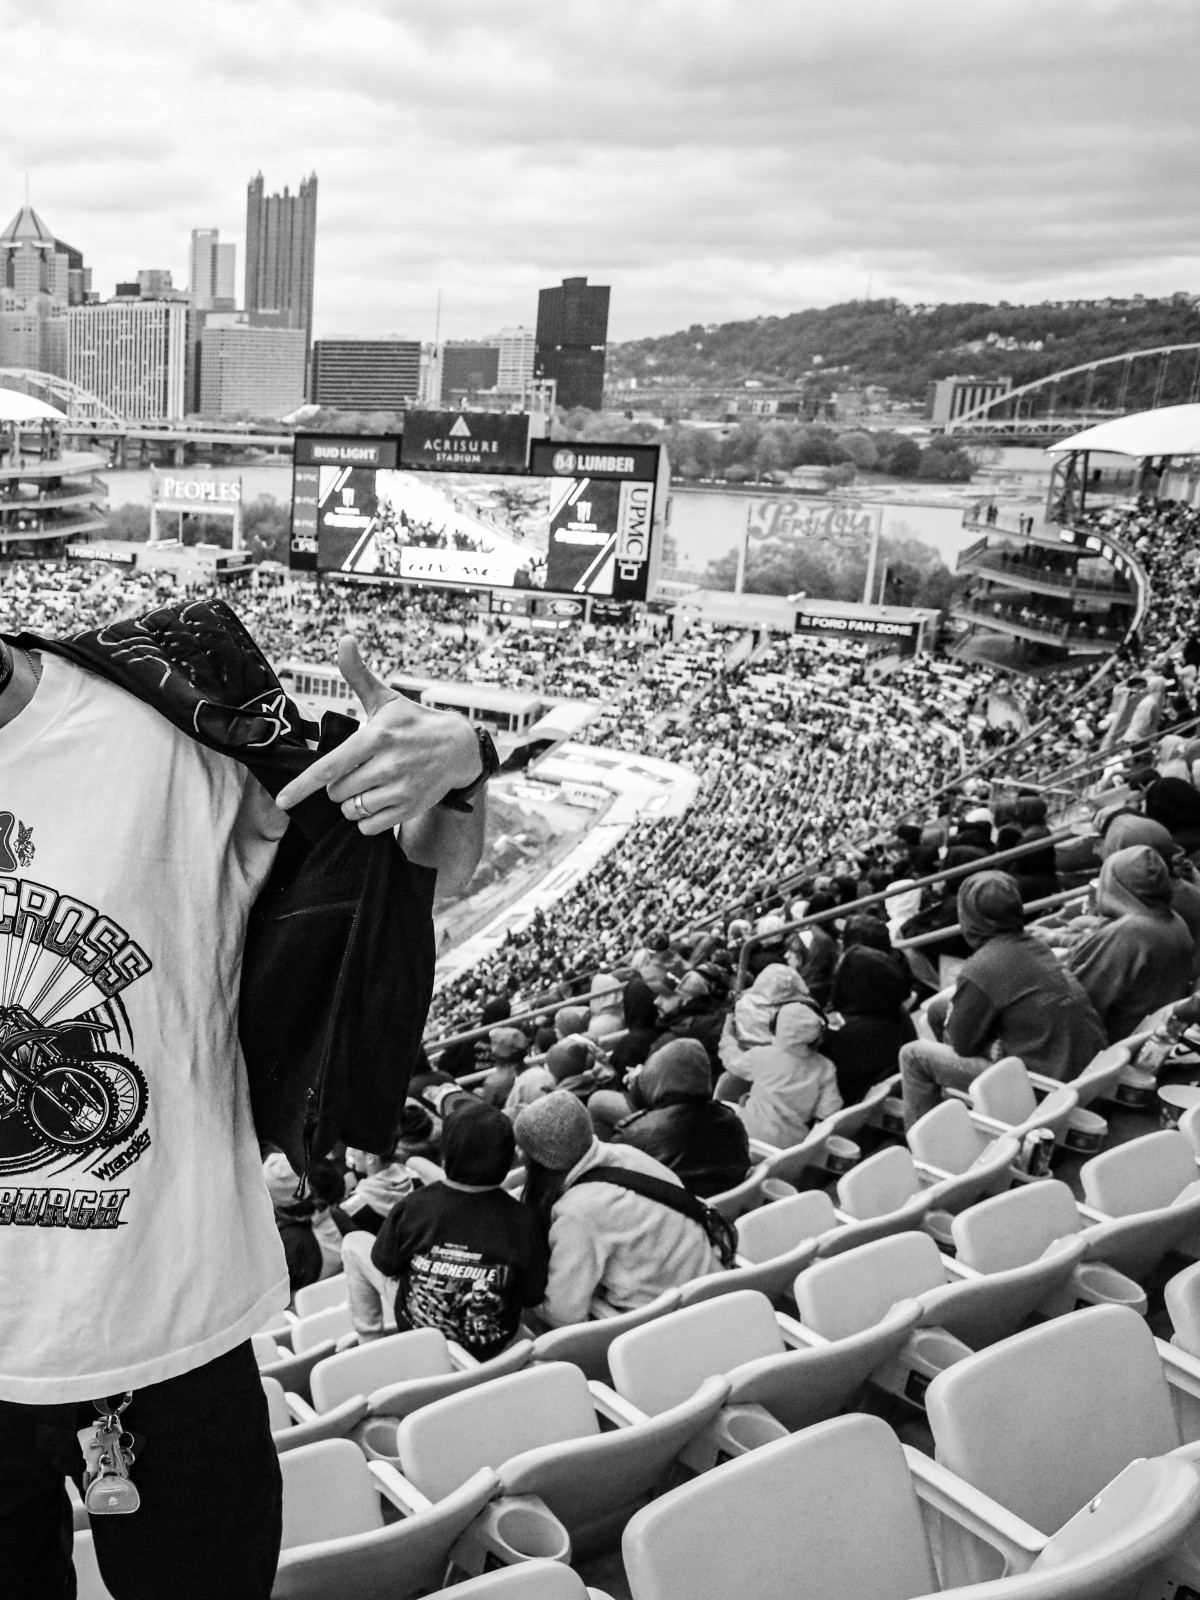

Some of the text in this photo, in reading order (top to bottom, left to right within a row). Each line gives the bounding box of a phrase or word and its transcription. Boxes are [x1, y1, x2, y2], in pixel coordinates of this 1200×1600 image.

[313, 446, 377, 461] BUD LIGHT
[424, 438, 499, 453] ACRISURE
[436, 452, 481, 463] STADIUM
[555, 454, 635, 472] 84 LUMBER
[163, 477, 241, 502] PEOPLES
[626, 487, 649, 556] UPMC
[811, 616, 913, 637] FORD FAN ZONE
[430, 1260, 497, 1282] SCHEDULE
